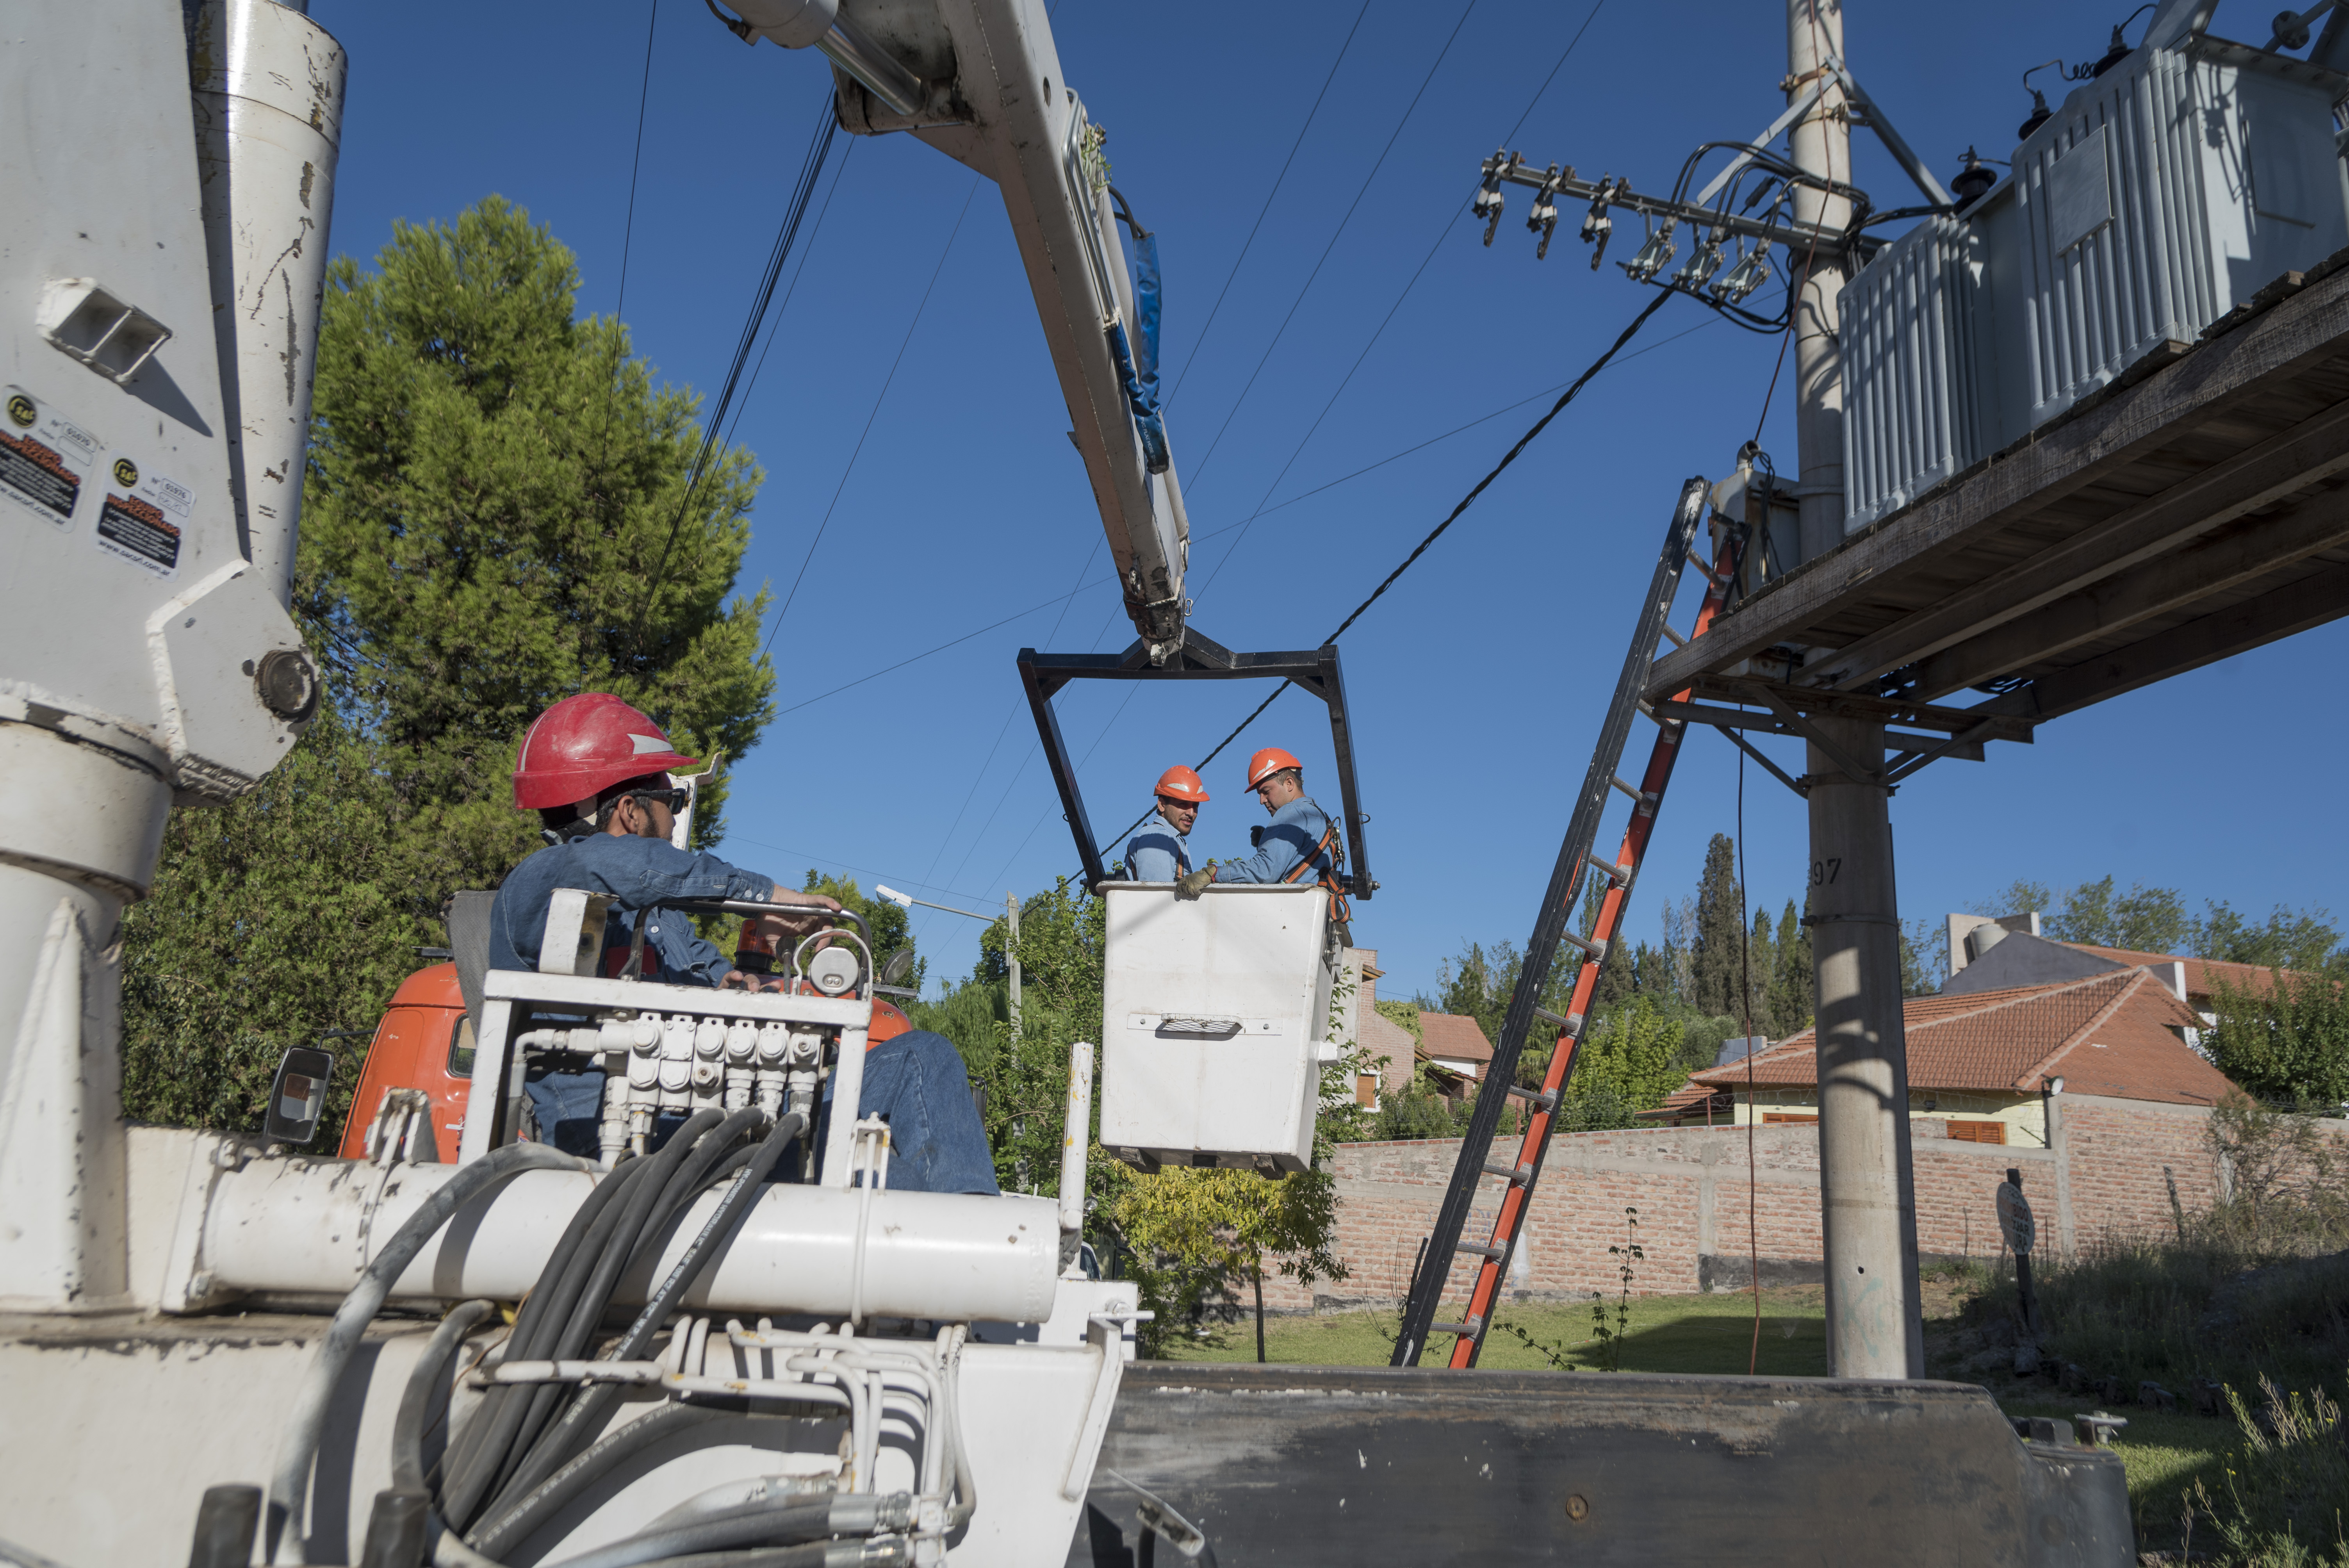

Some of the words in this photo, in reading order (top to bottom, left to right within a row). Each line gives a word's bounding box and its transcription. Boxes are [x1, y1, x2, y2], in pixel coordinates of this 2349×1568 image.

[165, 483, 187, 499] 01976
[723, 1169, 753, 1205] HY-POWER
[695, 1204, 728, 1245] HYDRAULIC
[681, 1247, 697, 1265] SAE
[672, 1265, 684, 1278] 100
[663, 1277, 676, 1290] R2
[655, 1288, 667, 1302] AT
[609, 1349, 623, 1361] BA
[565, 1403, 583, 1425] BAR
[619, 1419, 641, 1438] SAE
[603, 1433, 620, 1449] 100
[590, 1443, 604, 1458] R1
[577, 1452, 590, 1470] AT
[501, 1508, 524, 1531] BAR
